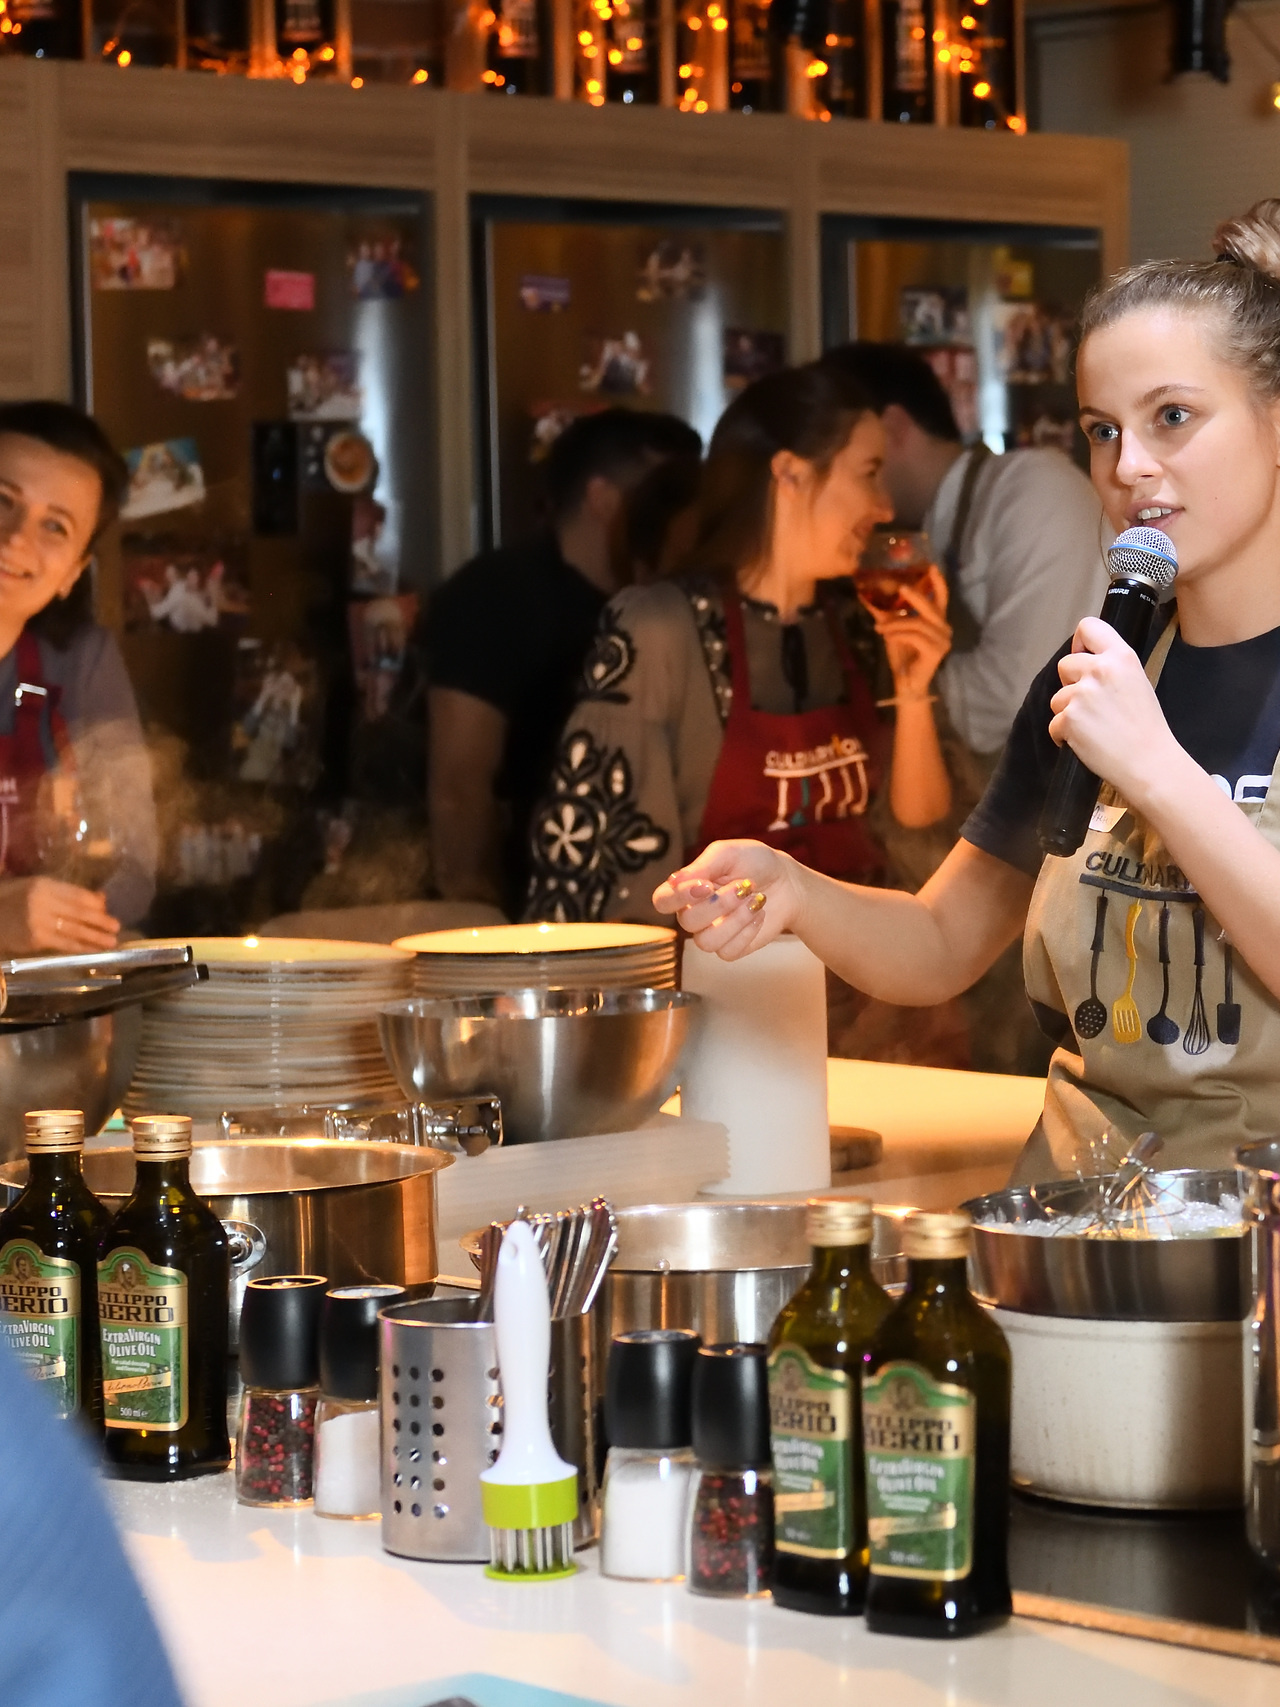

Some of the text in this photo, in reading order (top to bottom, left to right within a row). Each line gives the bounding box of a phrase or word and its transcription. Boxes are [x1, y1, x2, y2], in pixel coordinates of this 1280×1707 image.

[1086, 851, 1190, 890] CULINAR
[0, 1284, 61, 1297] ILIPPO
[0, 1296, 68, 1313] ERIO
[32, 1334, 50, 1348] OIL
[108, 1342, 156, 1357] OLIVE OIL
